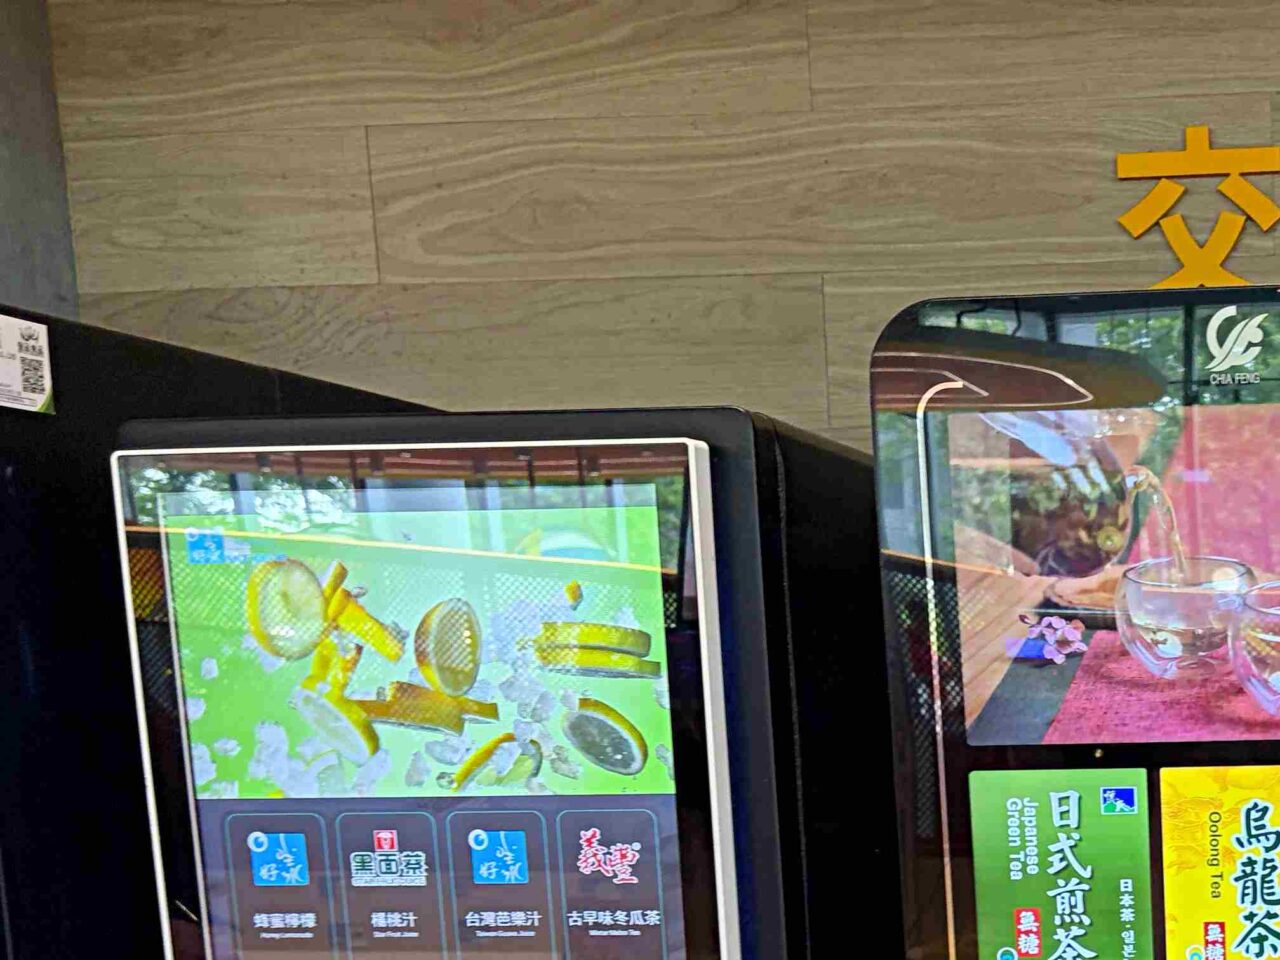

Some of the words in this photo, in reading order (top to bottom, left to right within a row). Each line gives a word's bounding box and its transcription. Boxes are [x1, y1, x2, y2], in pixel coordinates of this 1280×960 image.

[1210, 372, 1233, 385] CHIA
[1234, 372, 1261, 385] FENG
[1006, 796, 1022, 847] Green
[1022, 796, 1040, 876] Japanese
[1208, 811, 1223, 868] Oolong
[1009, 851, 1023, 881] Tea
[1210, 871, 1224, 900] Tea
[465, 911, 542, 927] 台灣芭樂汁
[567, 910, 661, 926] 古早味冬瓜茶
